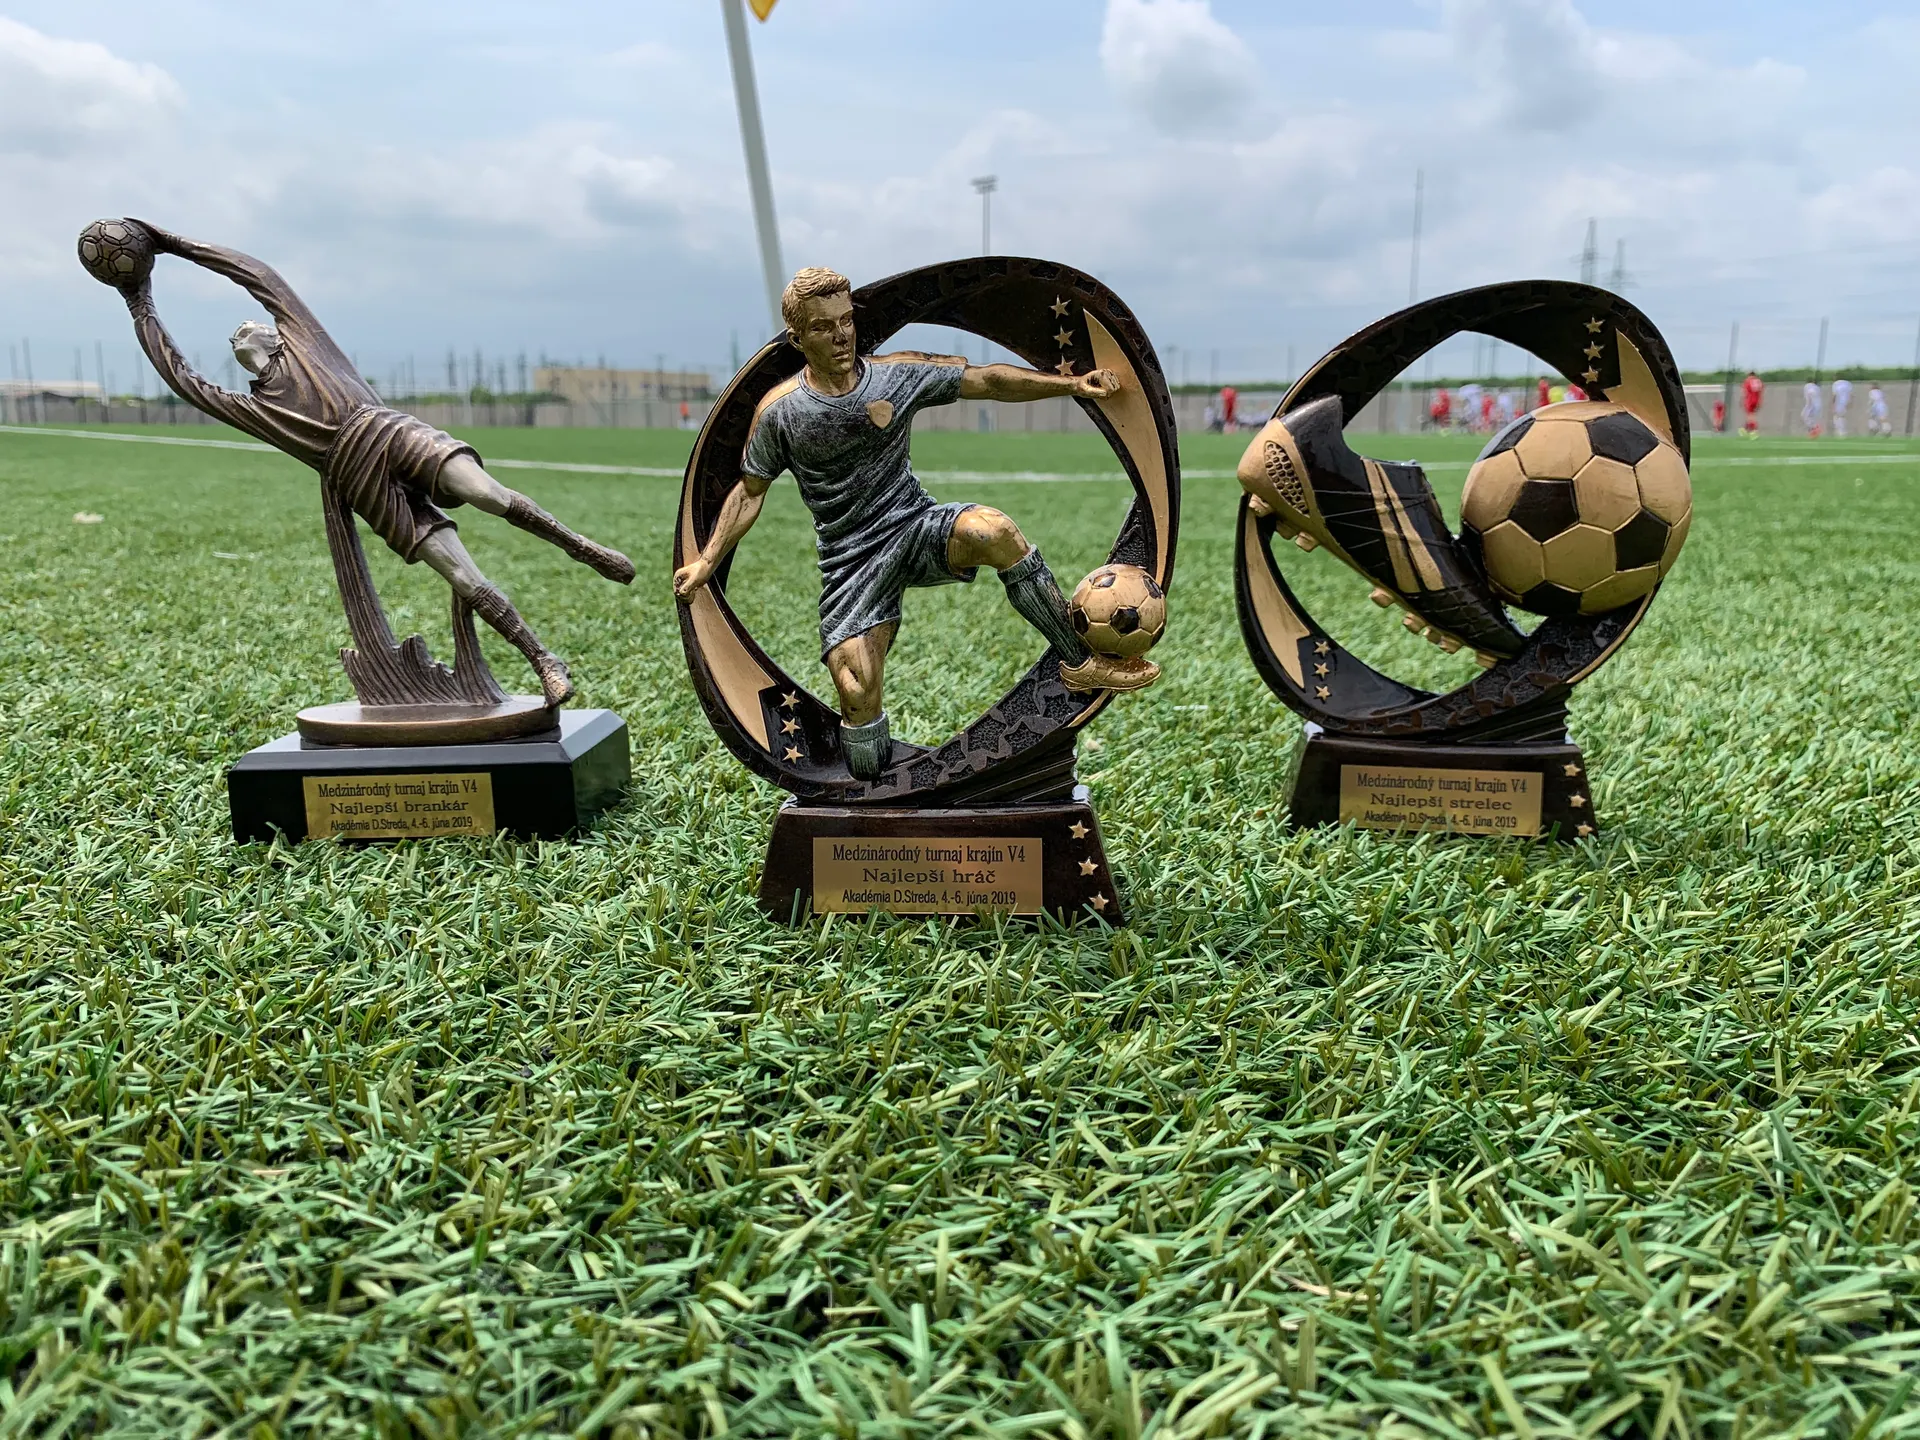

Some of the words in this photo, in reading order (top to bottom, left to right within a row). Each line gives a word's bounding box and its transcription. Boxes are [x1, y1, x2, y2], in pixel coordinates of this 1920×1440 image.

[318, 783, 391, 798] Medzinárodný
[395, 781, 426, 796] turnaj
[429, 780, 459, 796] krajín
[461, 779, 477, 793] V4
[1357, 773, 1434, 791] Medzinárodný
[1438, 777, 1471, 793] turnaj
[1474, 777, 1507, 794] krajín
[1511, 778, 1527, 793] V4
[331, 801, 399, 815] Najlepší
[404, 800, 469, 813] brankár
[1370, 793, 1442, 809] Najlepší
[1450, 798, 1512, 810] strelec
[330, 819, 370, 831] Akadémia
[431, 817, 450, 830] júna
[452, 816, 473, 828] 2019
[1472, 815, 1492, 828] júna
[1494, 815, 1517, 828] 2019
[833, 844, 920, 863] Medzinárodný
[925, 846, 962, 864] turnaj
[966, 845, 1003, 864] krajín
[1008, 845, 1025, 862] V4
[863, 868, 945, 884] Najlepší
[952, 869, 996, 883] hráč
[842, 889, 891, 903] Akadémia
[966, 891, 988, 906] júna
[991, 891, 1016, 904] 2019
